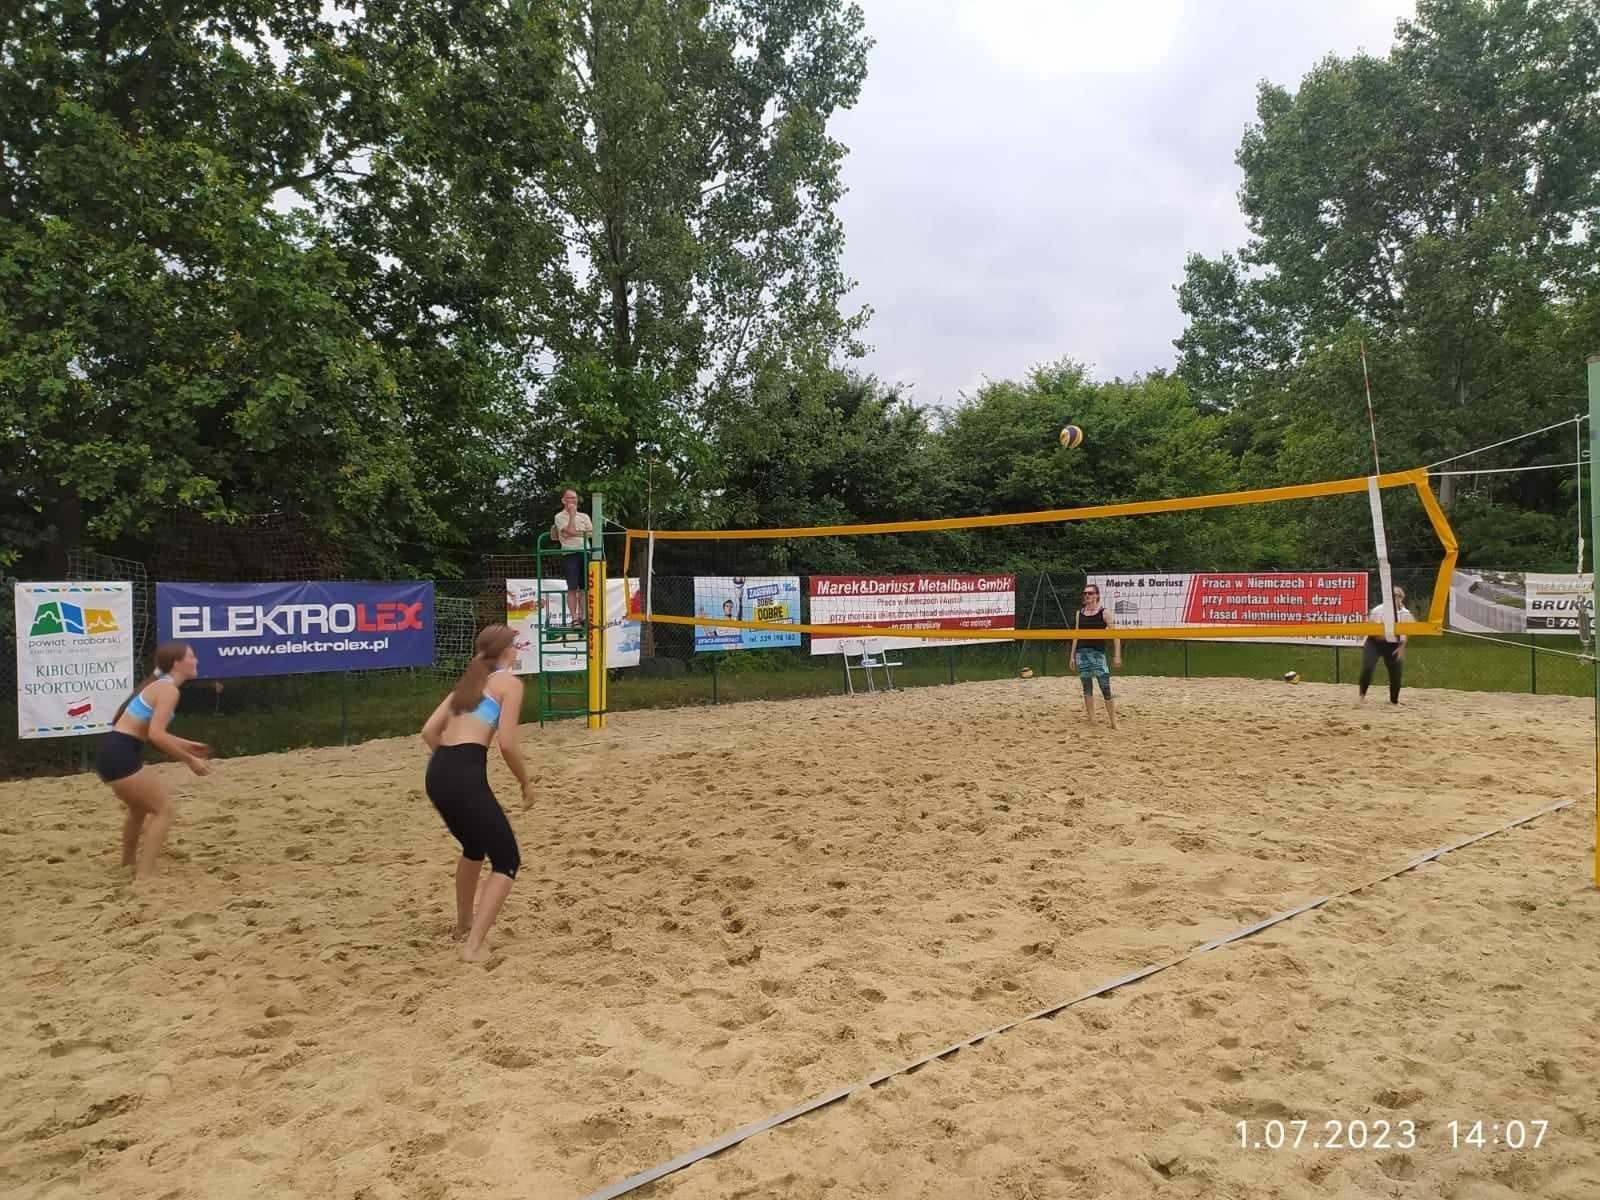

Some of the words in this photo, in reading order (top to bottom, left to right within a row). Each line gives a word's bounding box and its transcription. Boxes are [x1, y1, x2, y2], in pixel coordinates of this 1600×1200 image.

[817, 579, 915, 595] Marek&Dariusz
[918, 578, 974, 593] Metallbau
[977, 577, 1011, 591] GmbH
[1105, 578, 1135, 588] Marek
[1137, 578, 1145, 588] &
[1148, 578, 1183, 588] Dariusz
[1202, 578, 1231, 589] Praca
[1234, 580, 1243, 588] w
[1247, 577, 1304, 589] Niemczech
[1309, 577, 1313, 588] i
[1317, 577, 1355, 589] Austrii
[1202, 594, 1222, 606] przy
[1311, 594, 1341, 606] drzwi
[172, 602, 423, 638] ELEKTROLEX
[757, 606, 784, 621] DOBRE
[1209, 610, 1238, 620] fasad
[1241, 611, 1363, 624] aluminiowo-szklanych
[28, 637, 66, 649] powiat
[218, 638, 389, 657] www.elektrolex.pl
[35, 662, 118, 678] KIBICUJEMY
[24, 678, 128, 695] SPORTOWCOM
